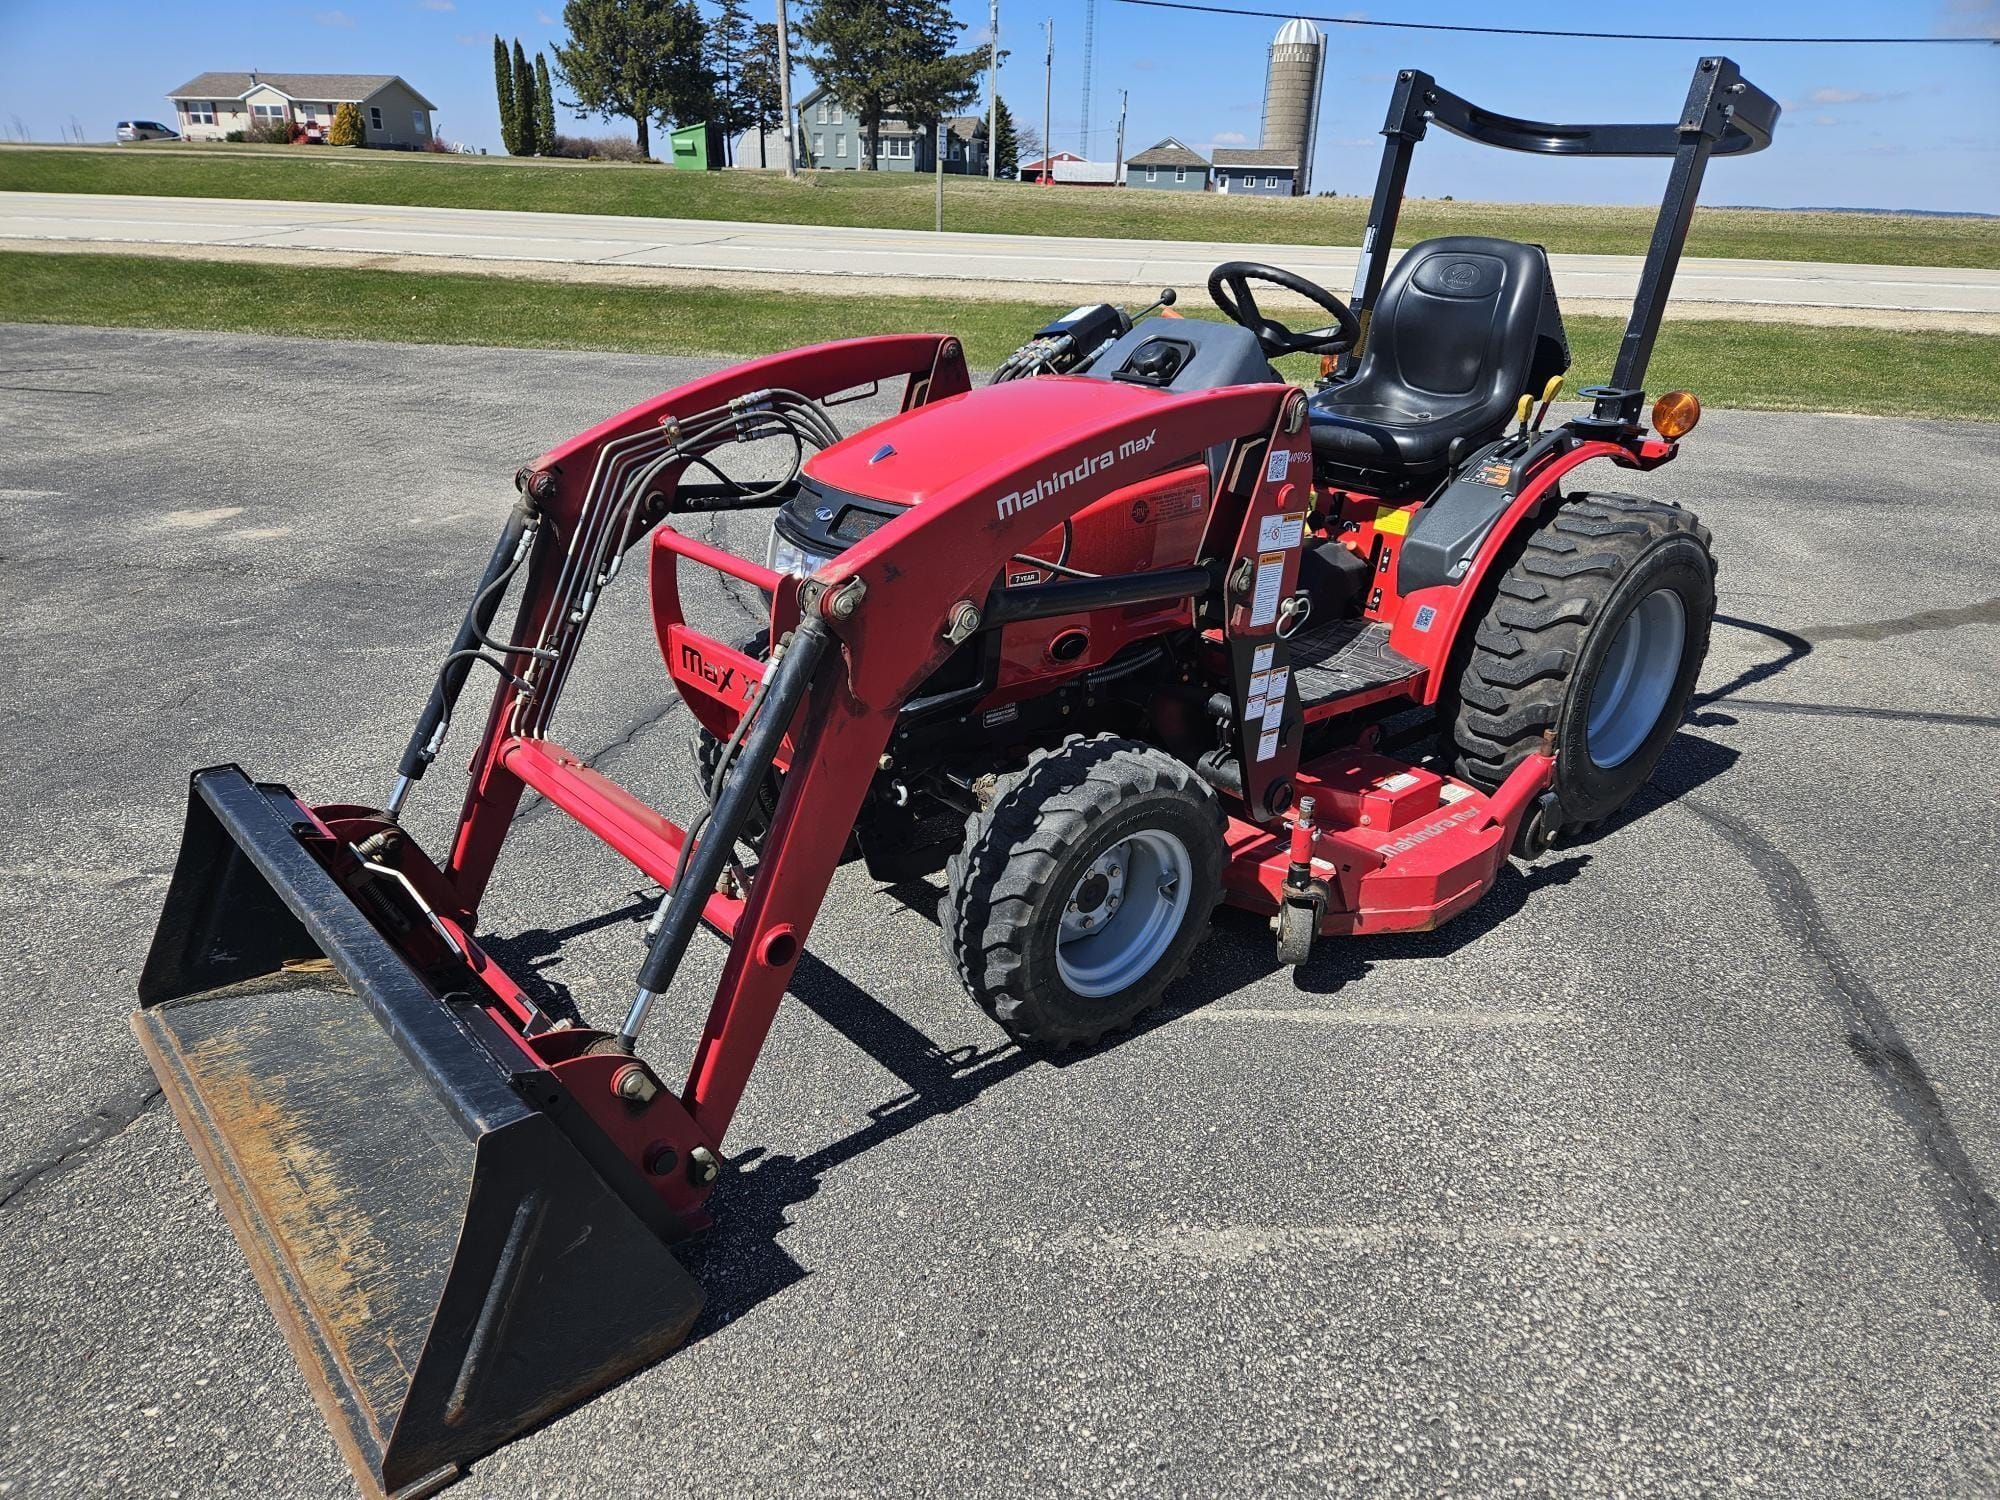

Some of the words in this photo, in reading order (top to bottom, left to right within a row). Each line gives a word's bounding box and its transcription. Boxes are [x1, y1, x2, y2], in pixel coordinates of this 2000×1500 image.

[996, 450, 1115, 520] Mahindra
[1020, 574, 1035, 582] YEAR
[1375, 819, 1458, 858] Mahindra
